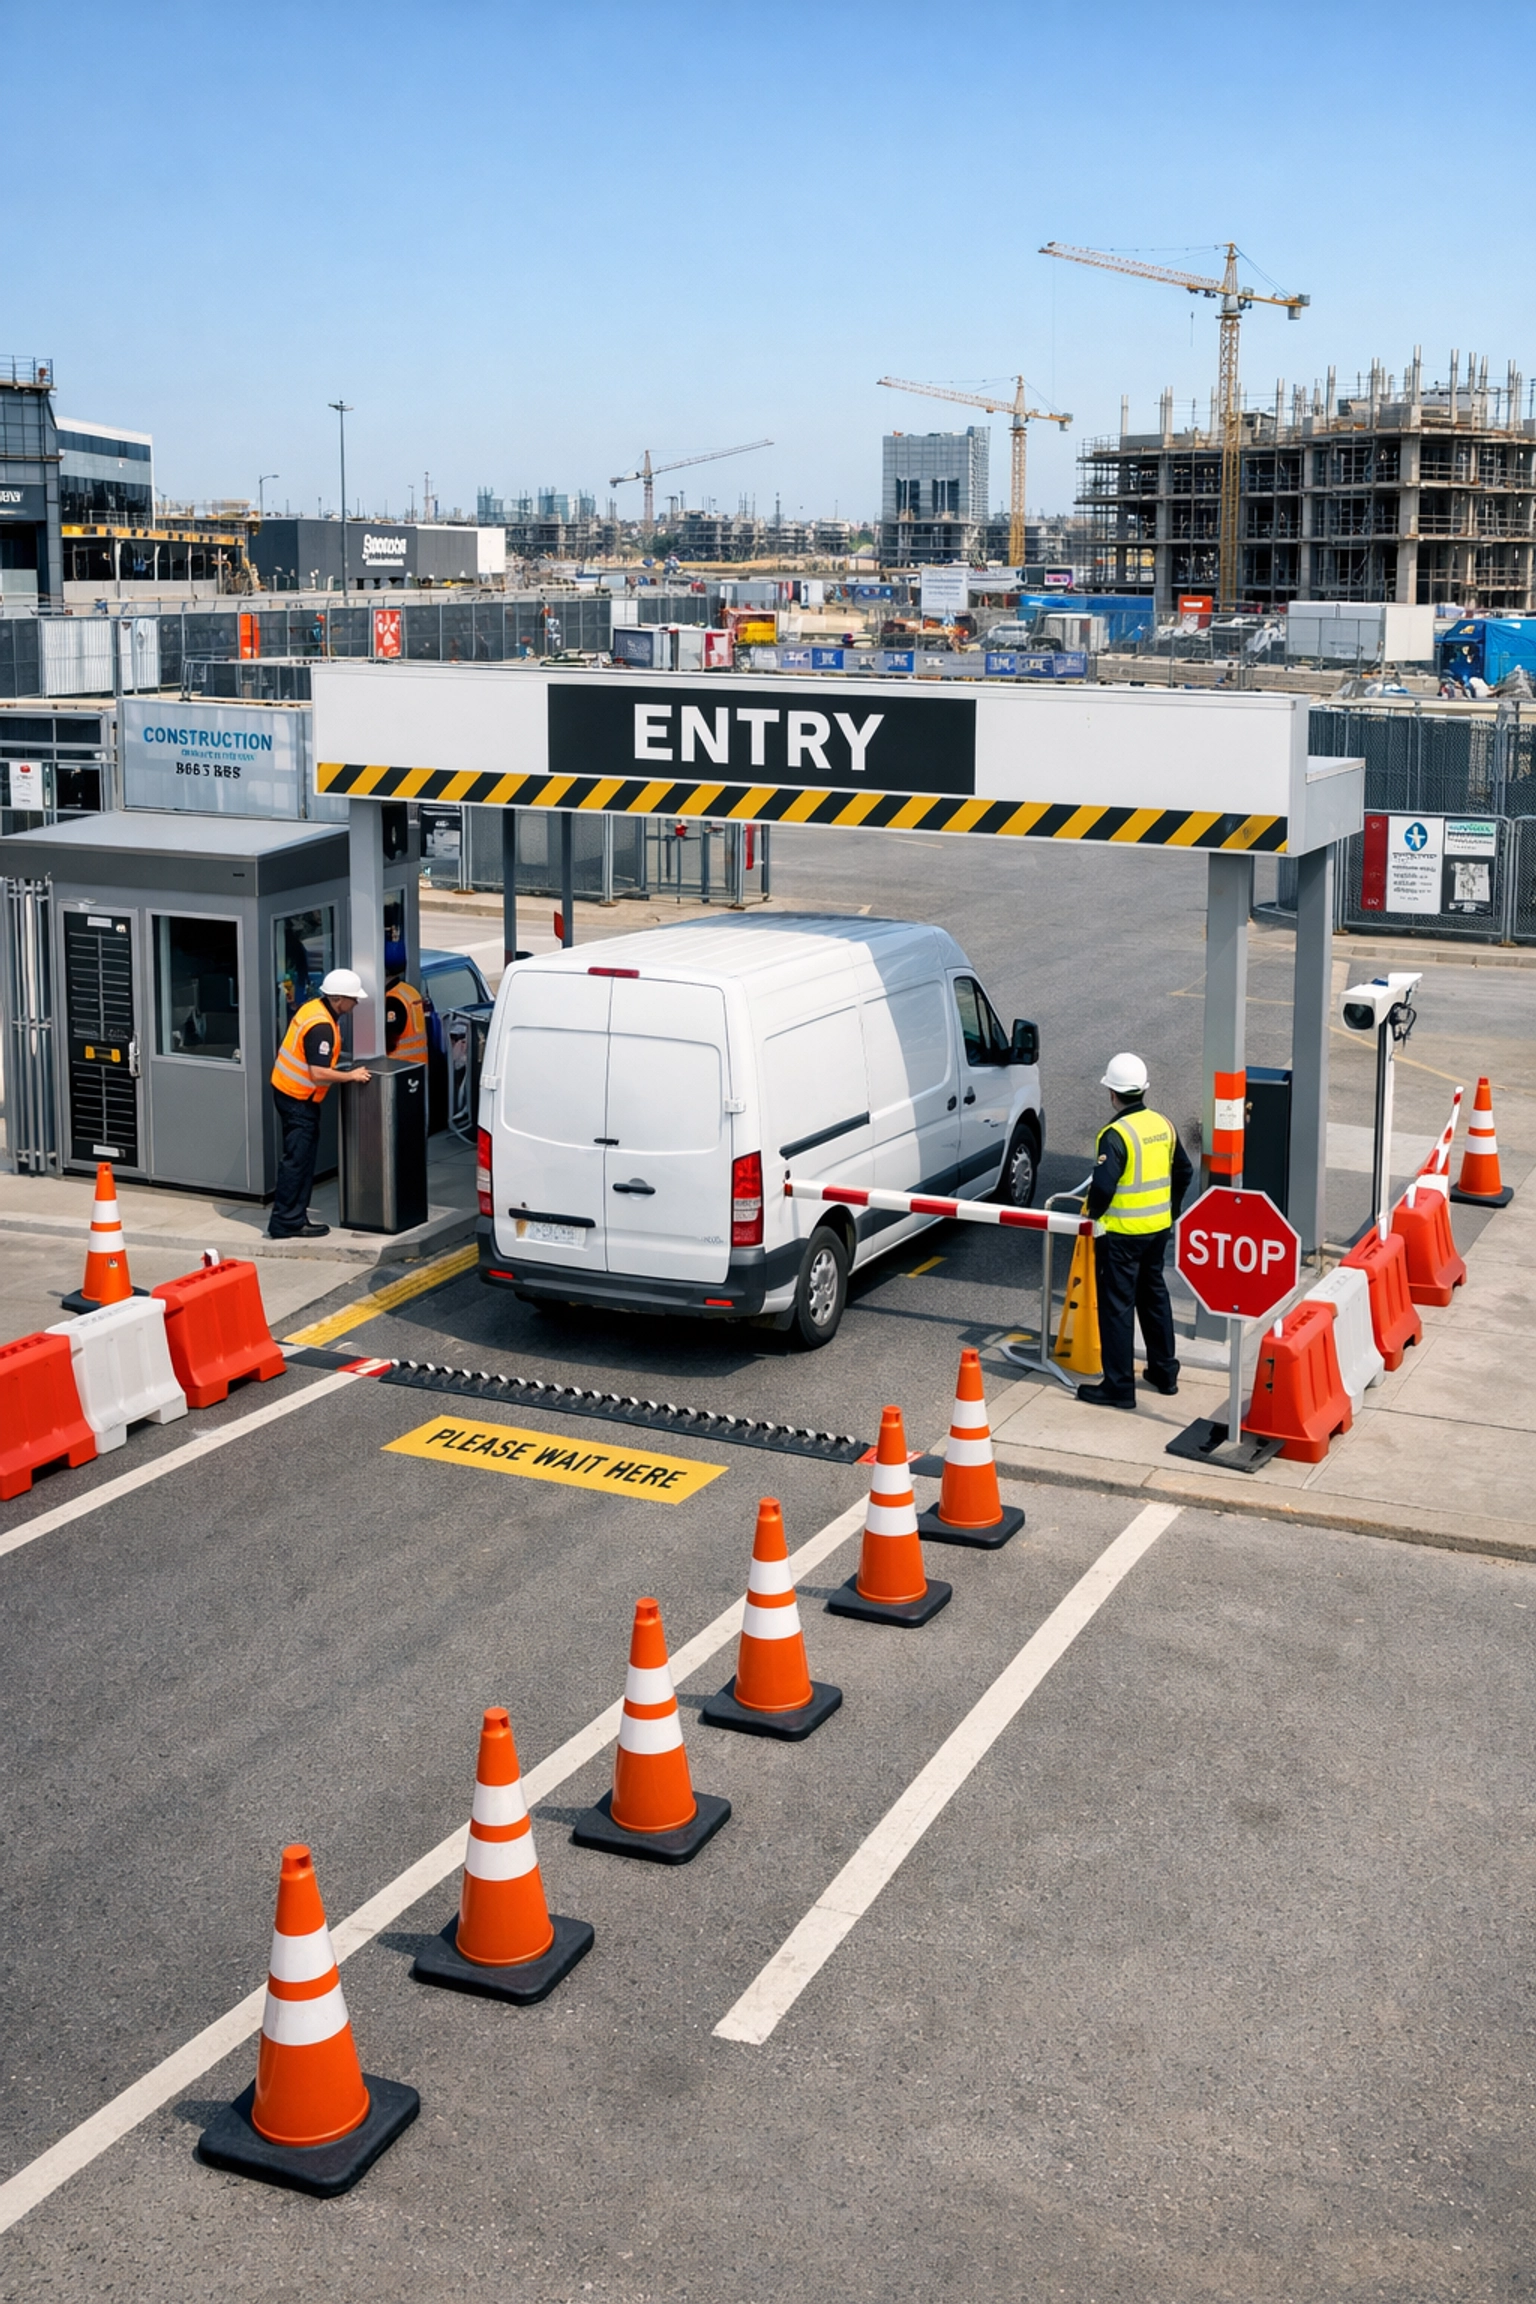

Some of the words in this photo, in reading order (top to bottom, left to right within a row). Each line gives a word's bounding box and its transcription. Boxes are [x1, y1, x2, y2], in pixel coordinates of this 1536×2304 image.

[143, 726, 273, 751] CONSTRUCTION
[634, 703, 885, 771] ENTRY
[1187, 1229, 1286, 1275] STOP
[425, 1428, 537, 1461] PLEASE
[532, 1446, 609, 1474] WAIT
[603, 1460, 688, 1489] HERE
